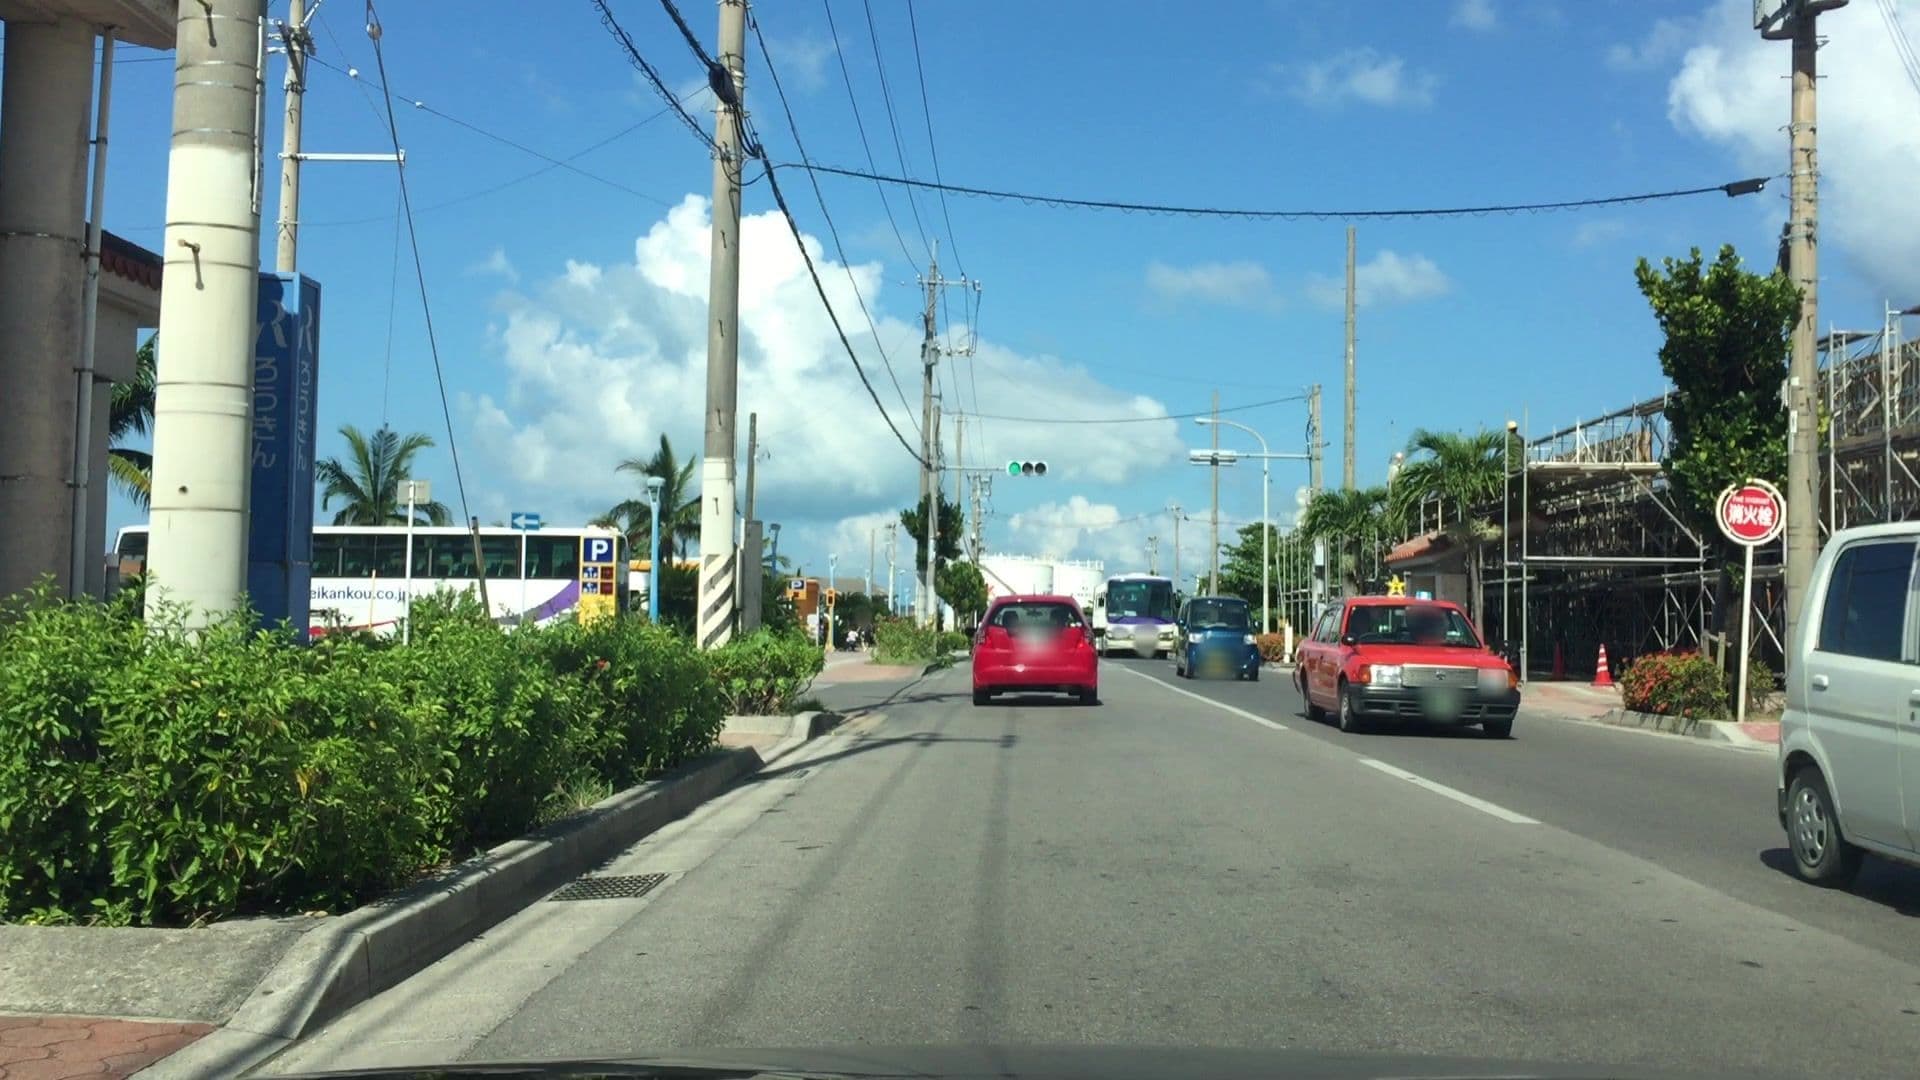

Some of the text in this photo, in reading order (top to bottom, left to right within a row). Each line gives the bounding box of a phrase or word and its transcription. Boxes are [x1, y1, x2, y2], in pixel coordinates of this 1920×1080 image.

[1728, 503, 1774, 526] 消火栓
[591, 539, 609, 561] P
